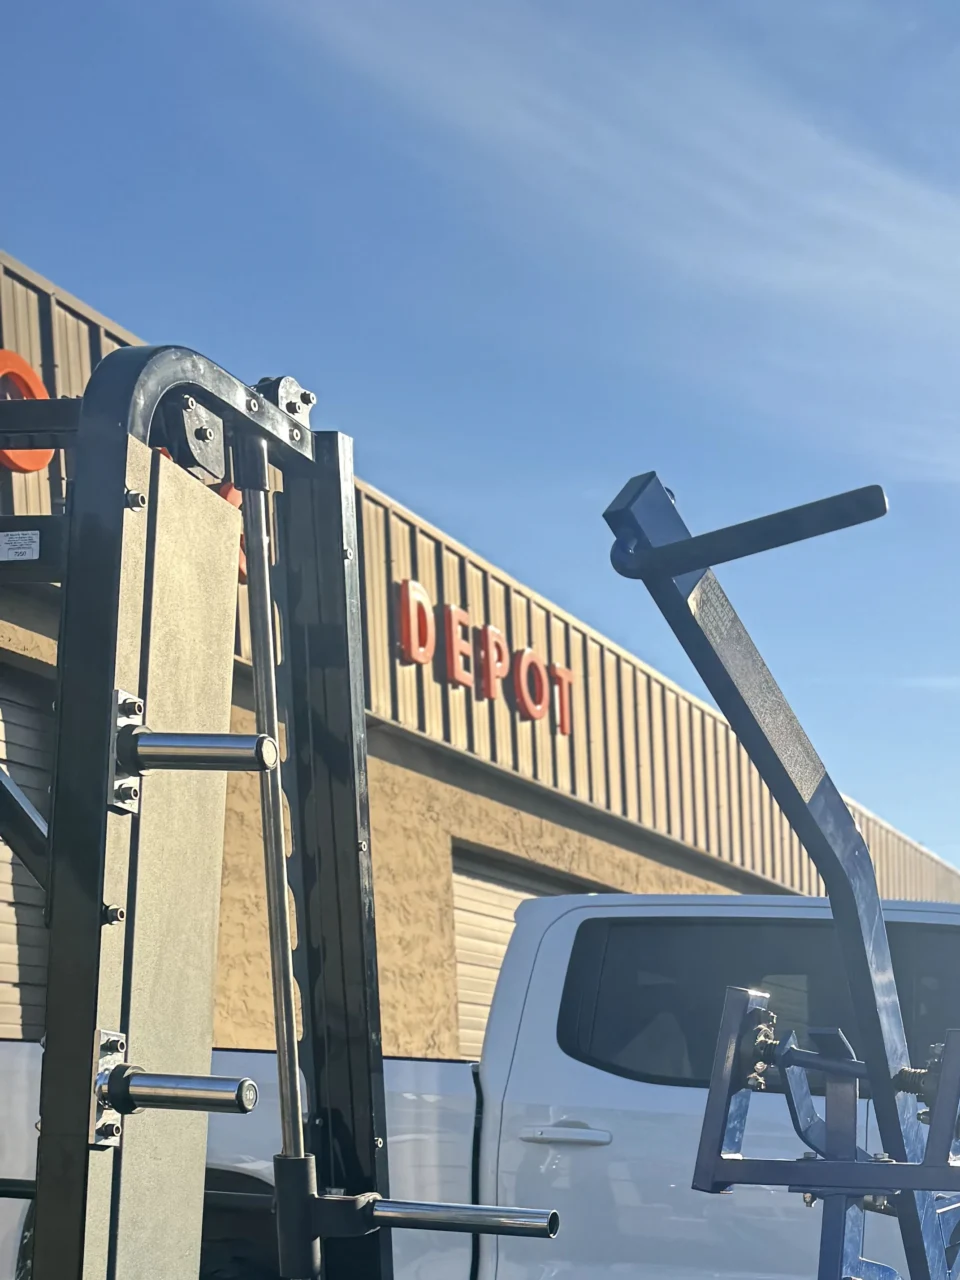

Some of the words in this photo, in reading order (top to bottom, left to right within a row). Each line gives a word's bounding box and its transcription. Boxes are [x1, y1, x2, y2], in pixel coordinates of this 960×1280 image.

[701, 581, 732, 628] STRENGTH
[708, 577, 735, 618] HAMMER
[402, 579, 573, 736] DEPOT
[246, 1090, 254, 1100] 10
